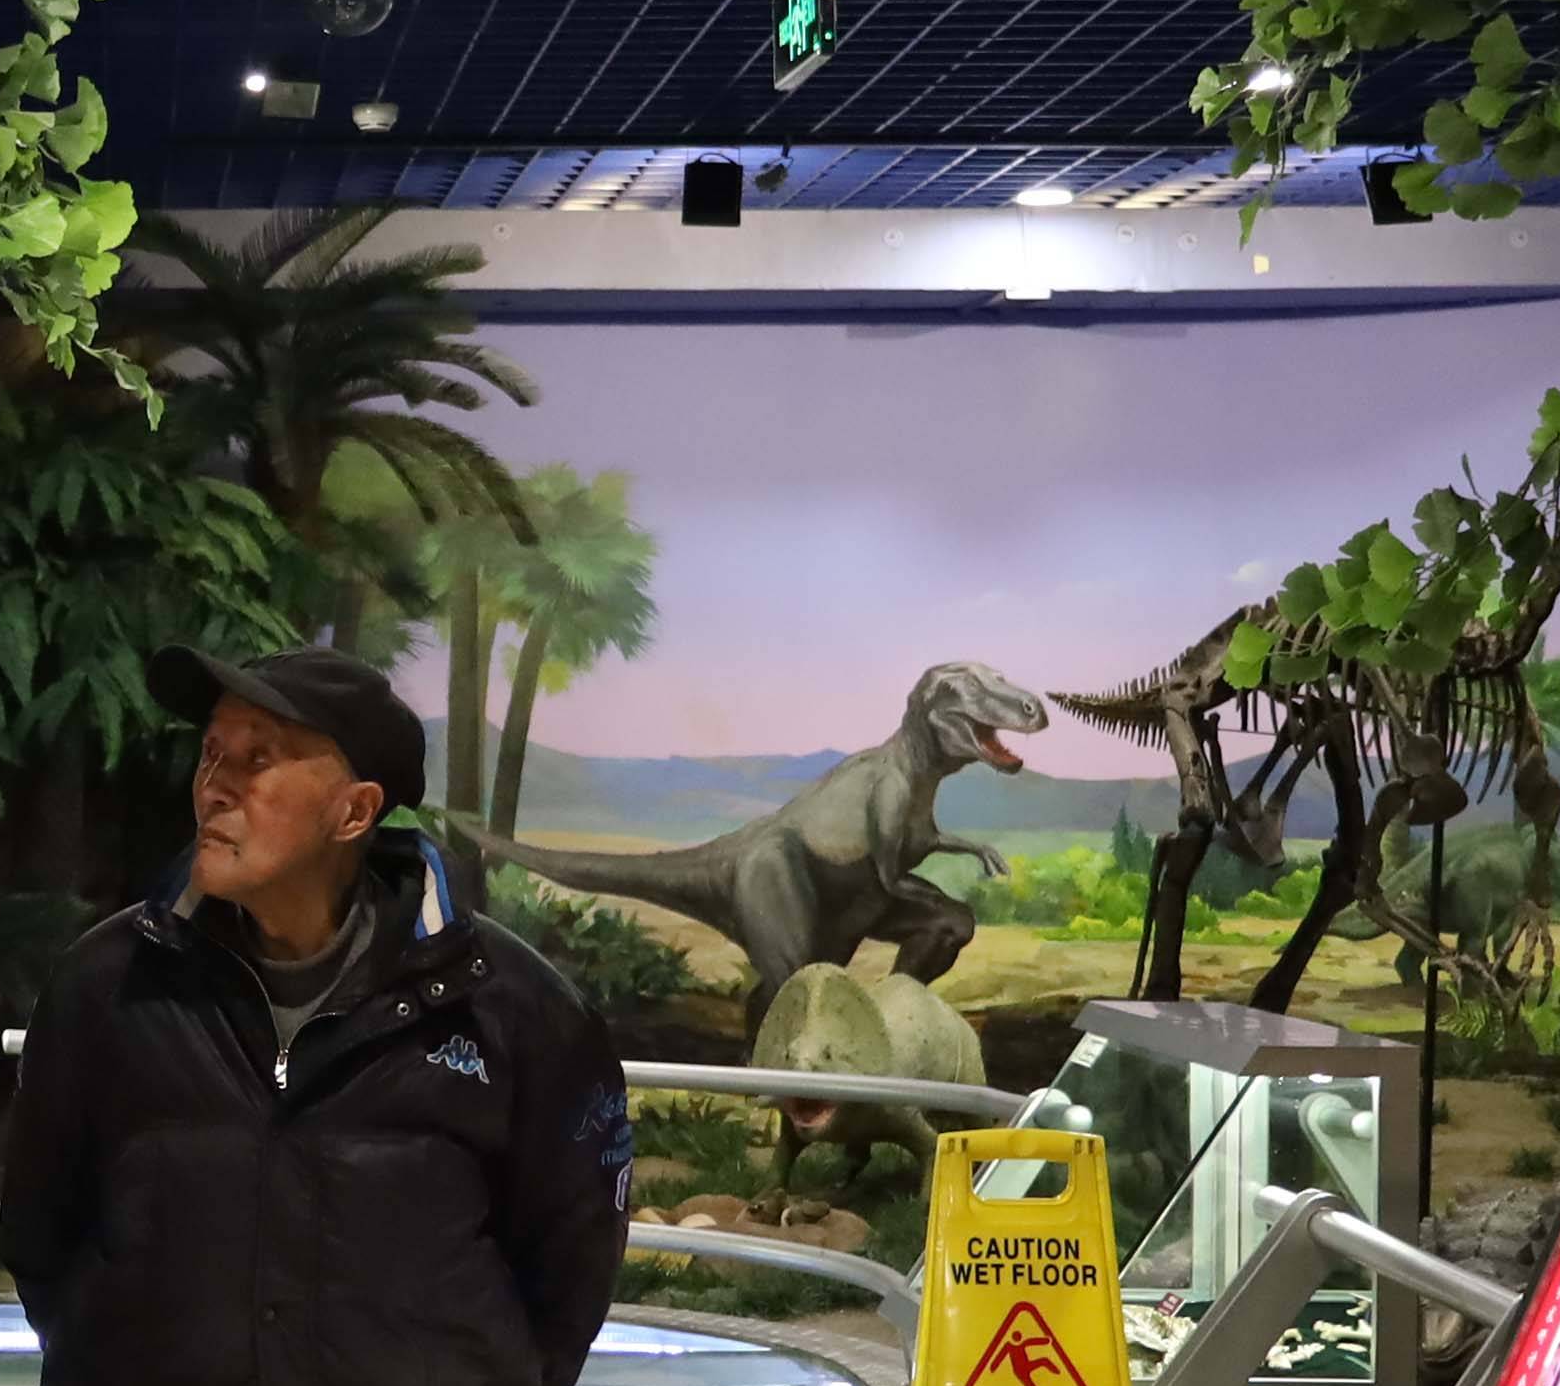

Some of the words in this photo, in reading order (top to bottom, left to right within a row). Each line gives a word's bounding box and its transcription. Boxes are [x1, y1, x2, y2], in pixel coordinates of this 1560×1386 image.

[967, 1237, 1080, 1259] CAUTION
[952, 1263, 1004, 1285] WET
[1012, 1264, 1097, 1286] FLOOR
